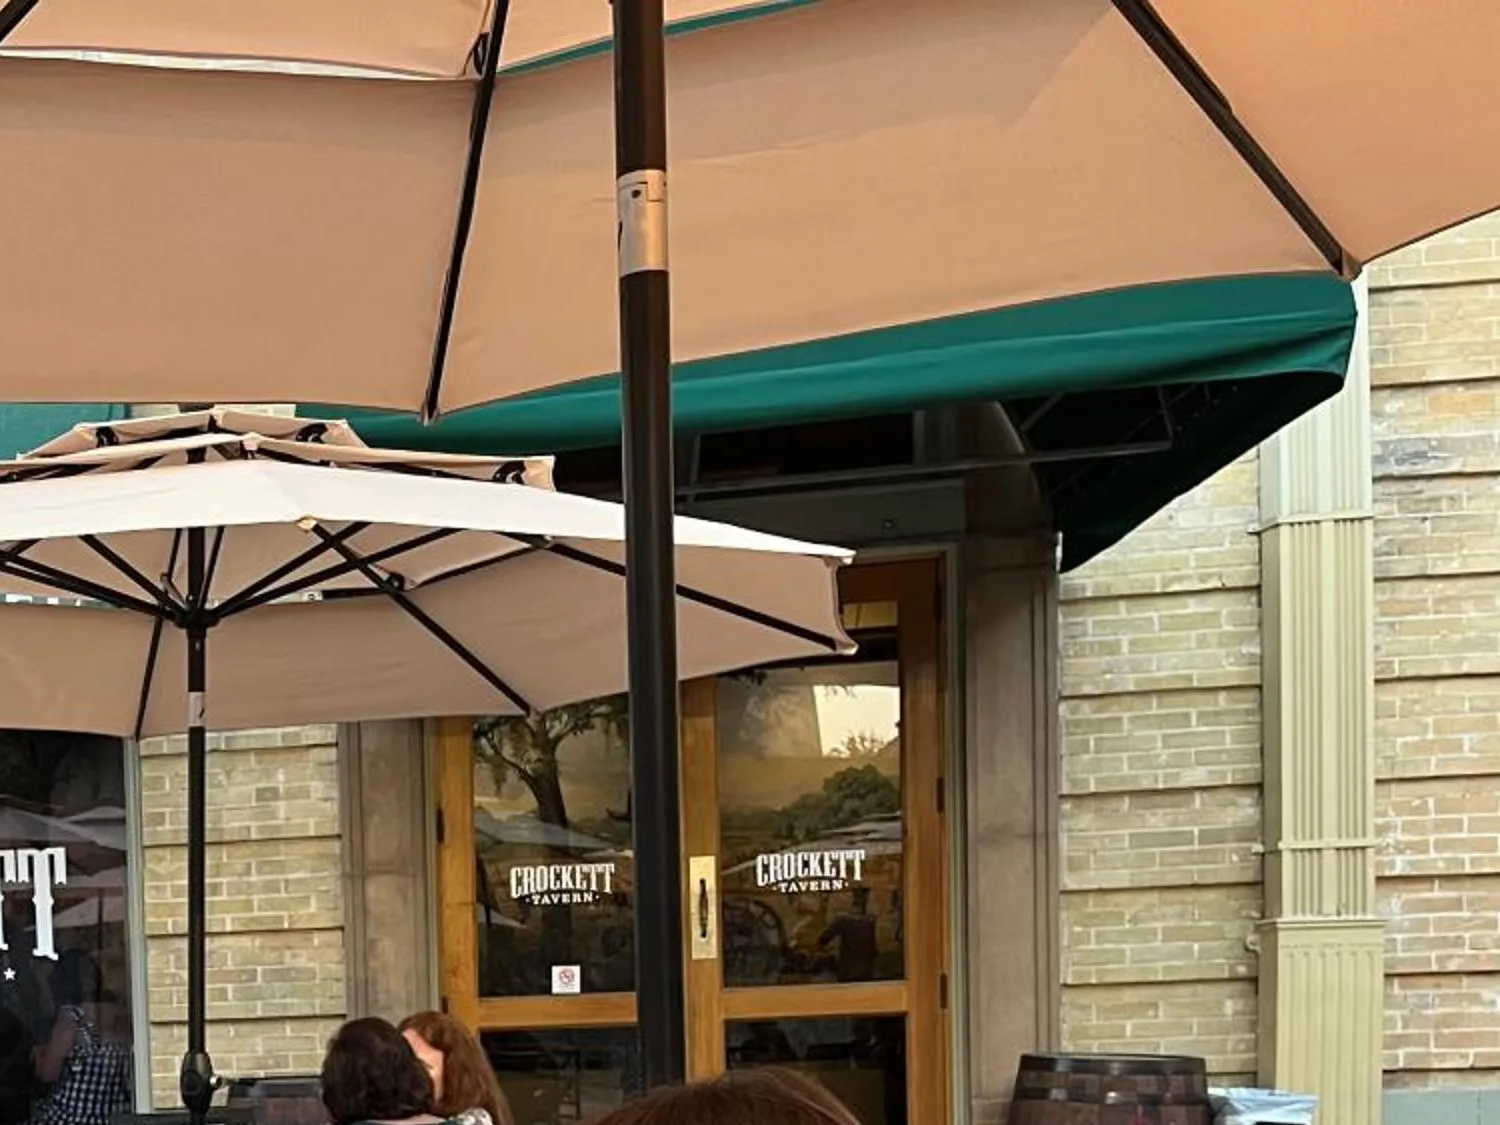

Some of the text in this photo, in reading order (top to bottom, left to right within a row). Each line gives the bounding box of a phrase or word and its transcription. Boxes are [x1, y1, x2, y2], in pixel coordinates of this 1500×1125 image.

[756, 849, 865, 887] CROCKETT
[510, 863, 615, 899] CROCKETT
[778, 879, 843, 893] TAVERN
[531, 891, 594, 905] TAVERN
